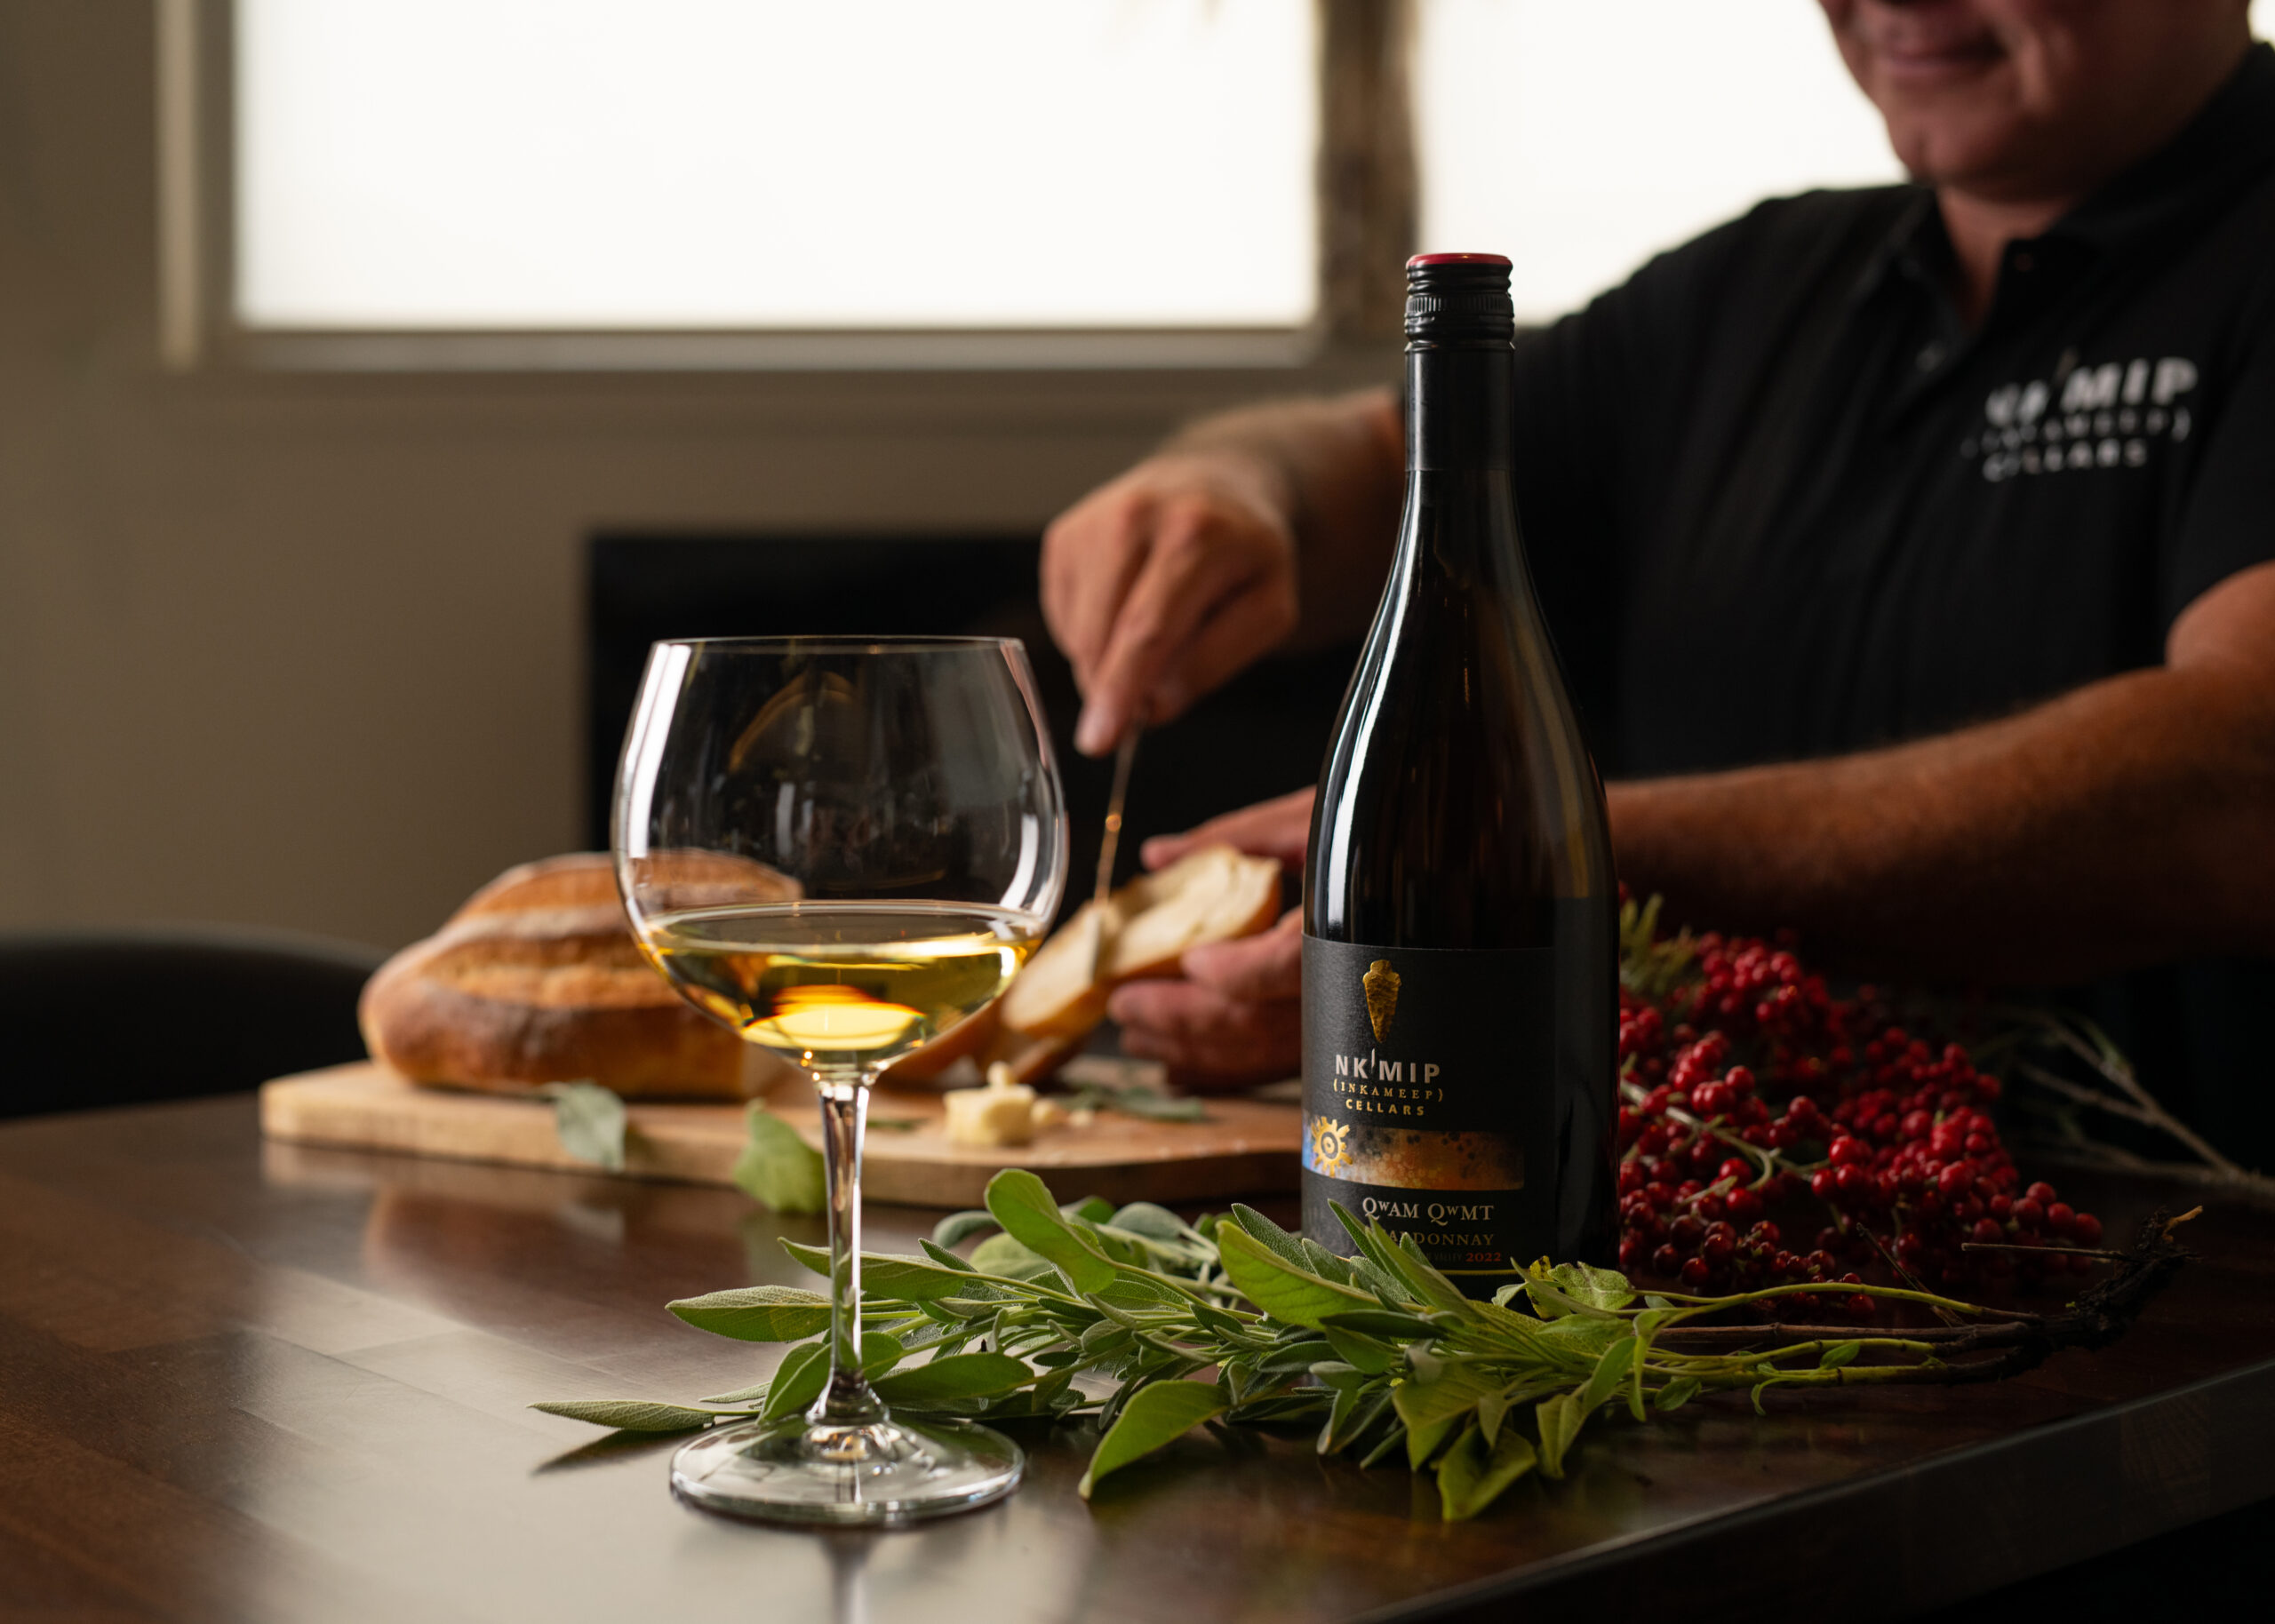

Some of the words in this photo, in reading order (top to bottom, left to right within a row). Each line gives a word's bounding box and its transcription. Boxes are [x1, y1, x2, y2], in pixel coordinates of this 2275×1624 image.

[1335, 1048, 1441, 1084] NK'MIP
[1333, 1078, 1444, 1103] (INKAMEEP)
[1345, 1098, 1425, 1117] CELLARS
[1465, 1252, 1502, 1263] 2022
